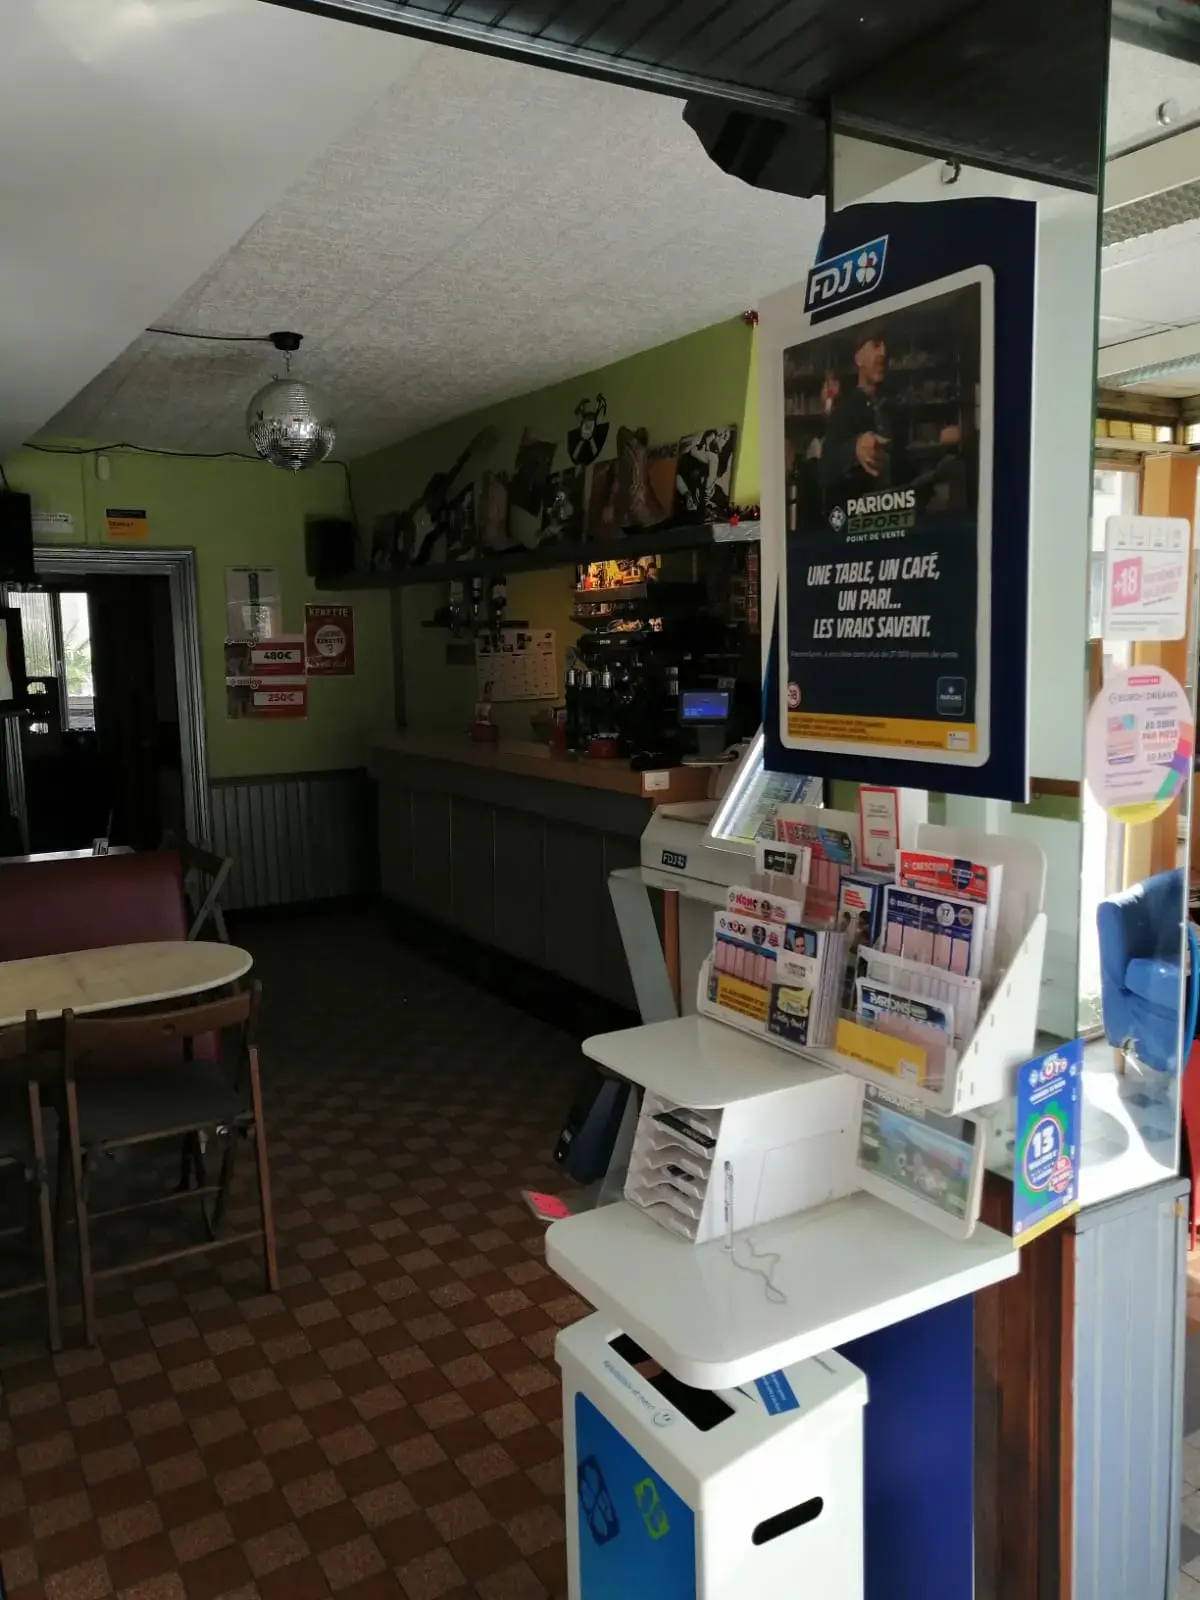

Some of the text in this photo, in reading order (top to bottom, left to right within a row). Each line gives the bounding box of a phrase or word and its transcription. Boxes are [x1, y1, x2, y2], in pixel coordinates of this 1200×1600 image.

[808, 259, 854, 305] FDJ
[846, 489, 916, 516] PARIONS
[849, 512, 913, 531] SPORT
[846, 530, 906, 543] POINT DE VENTE
[806, 551, 941, 586] UNE TABLE, UN CAFÉ,
[1112, 566, 1138, 598] +18
[837, 587, 902, 612] UN PARI...
[812, 615, 931, 639] LES VRAIS SAVENT.
[663, 852, 677, 865] FDJ
[1033, 1125, 1054, 1159] 13
